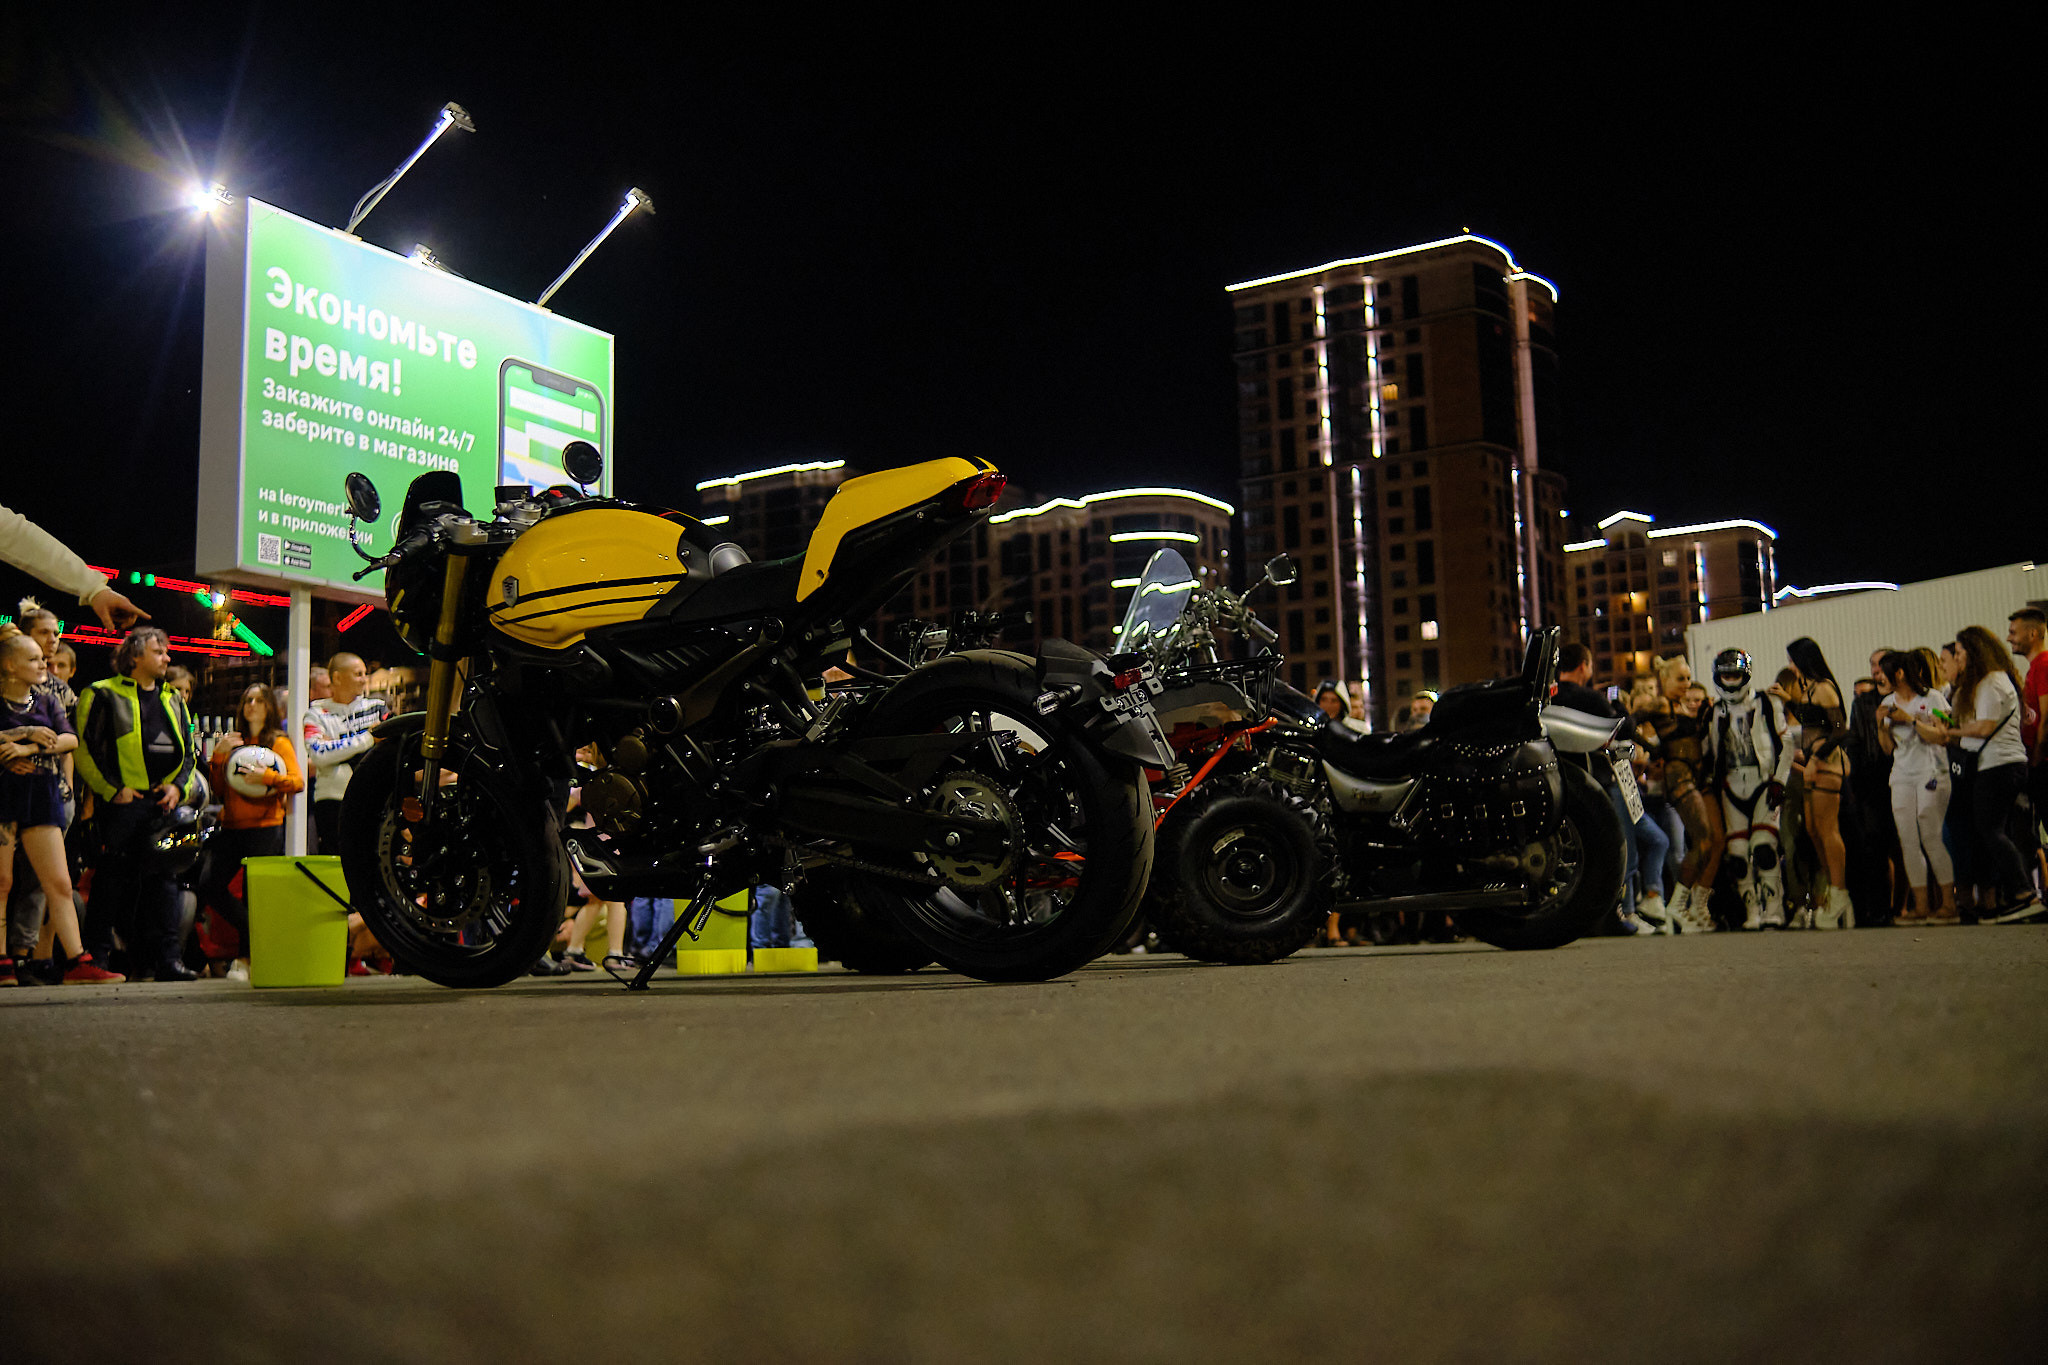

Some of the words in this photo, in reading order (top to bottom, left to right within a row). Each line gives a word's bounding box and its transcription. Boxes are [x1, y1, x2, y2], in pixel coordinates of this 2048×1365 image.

[266, 267, 478, 370] Экономьте
[265, 327, 402, 397] время!
[261, 409, 355, 448] заберите
[359, 434, 370, 451] в
[373, 438, 459, 473] магазине
[262, 377, 364, 423] Закажите
[367, 410, 435, 443] онлайн
[438, 426, 475, 453] 24/7
[258, 487, 277, 502] на
[258, 509, 269, 523] и
[271, 512, 280, 526] в
